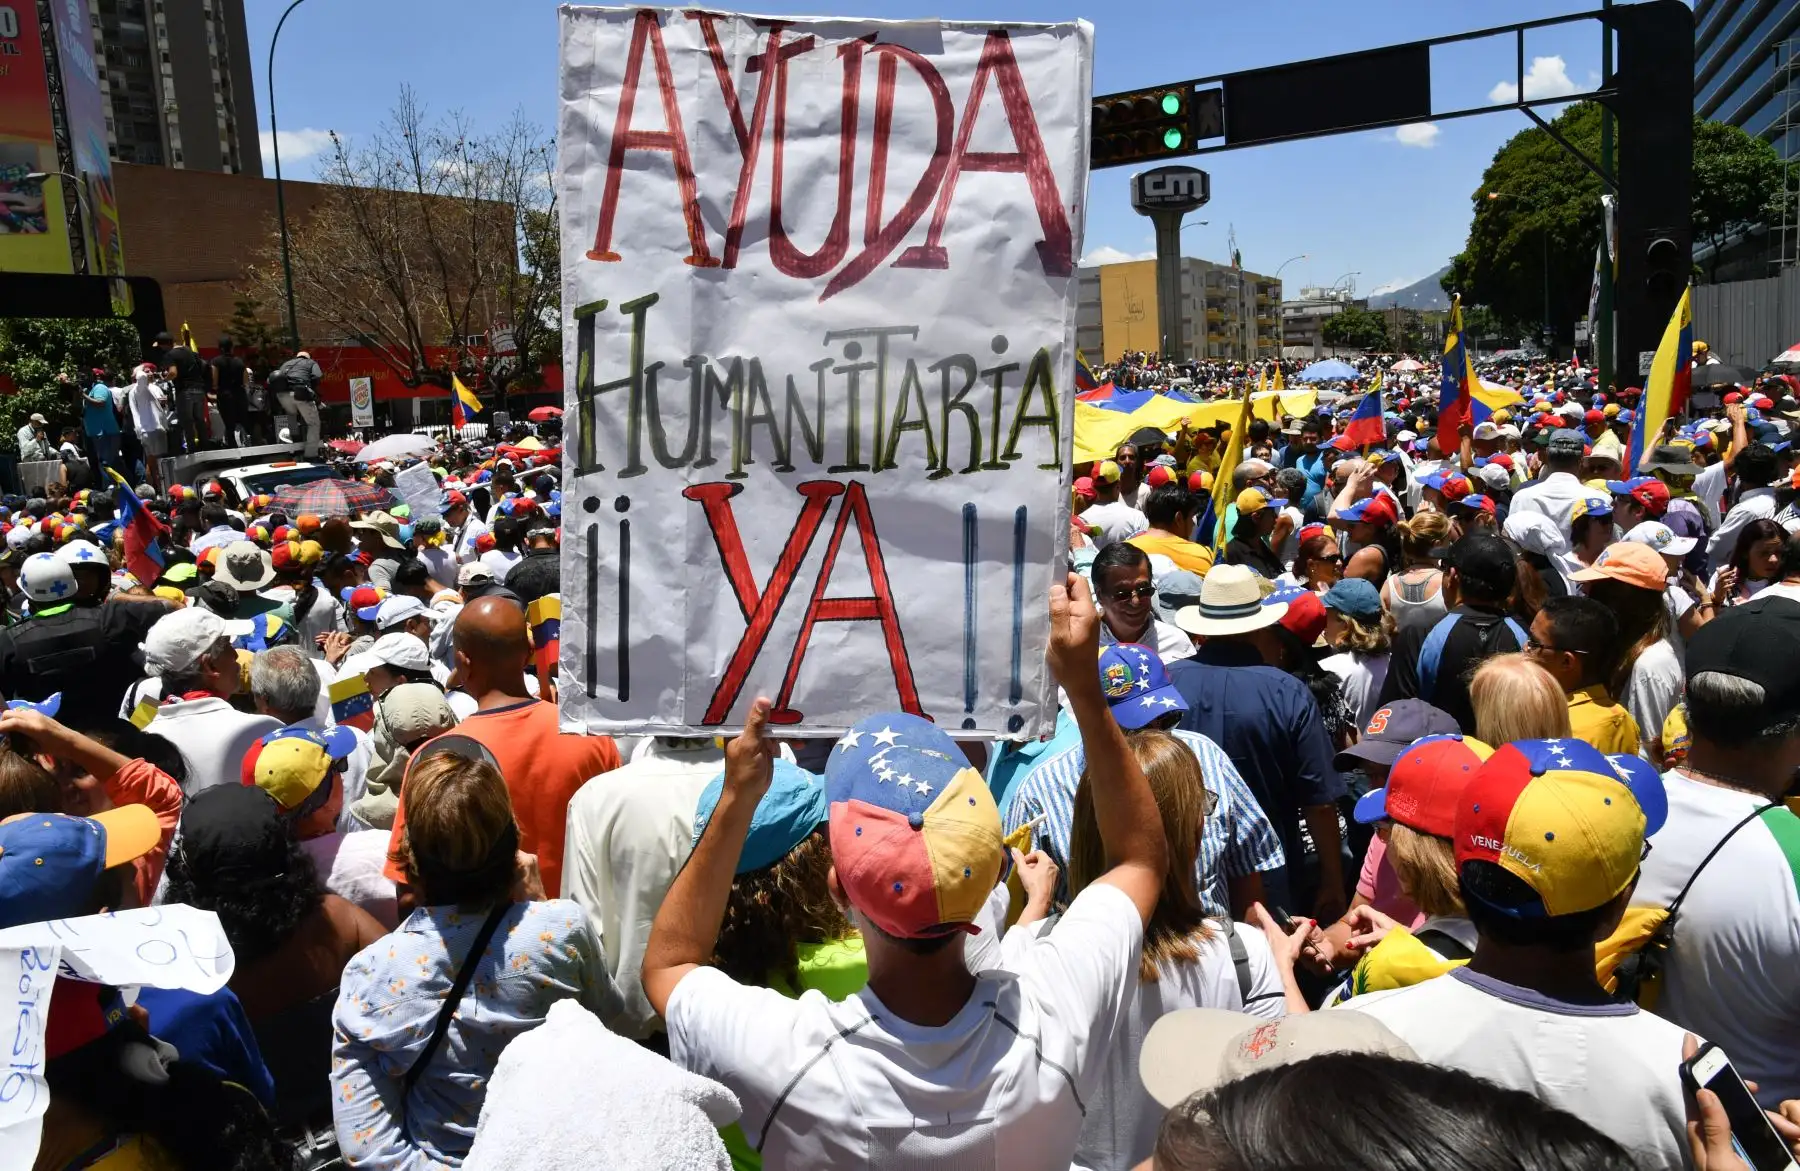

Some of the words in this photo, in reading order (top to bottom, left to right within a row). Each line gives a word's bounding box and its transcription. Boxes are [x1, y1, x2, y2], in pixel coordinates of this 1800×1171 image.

[586, 8, 1074, 303] AYUDA
[1366, 708, 1393, 735] S
[1470, 834, 1541, 874] VENEZUELA
